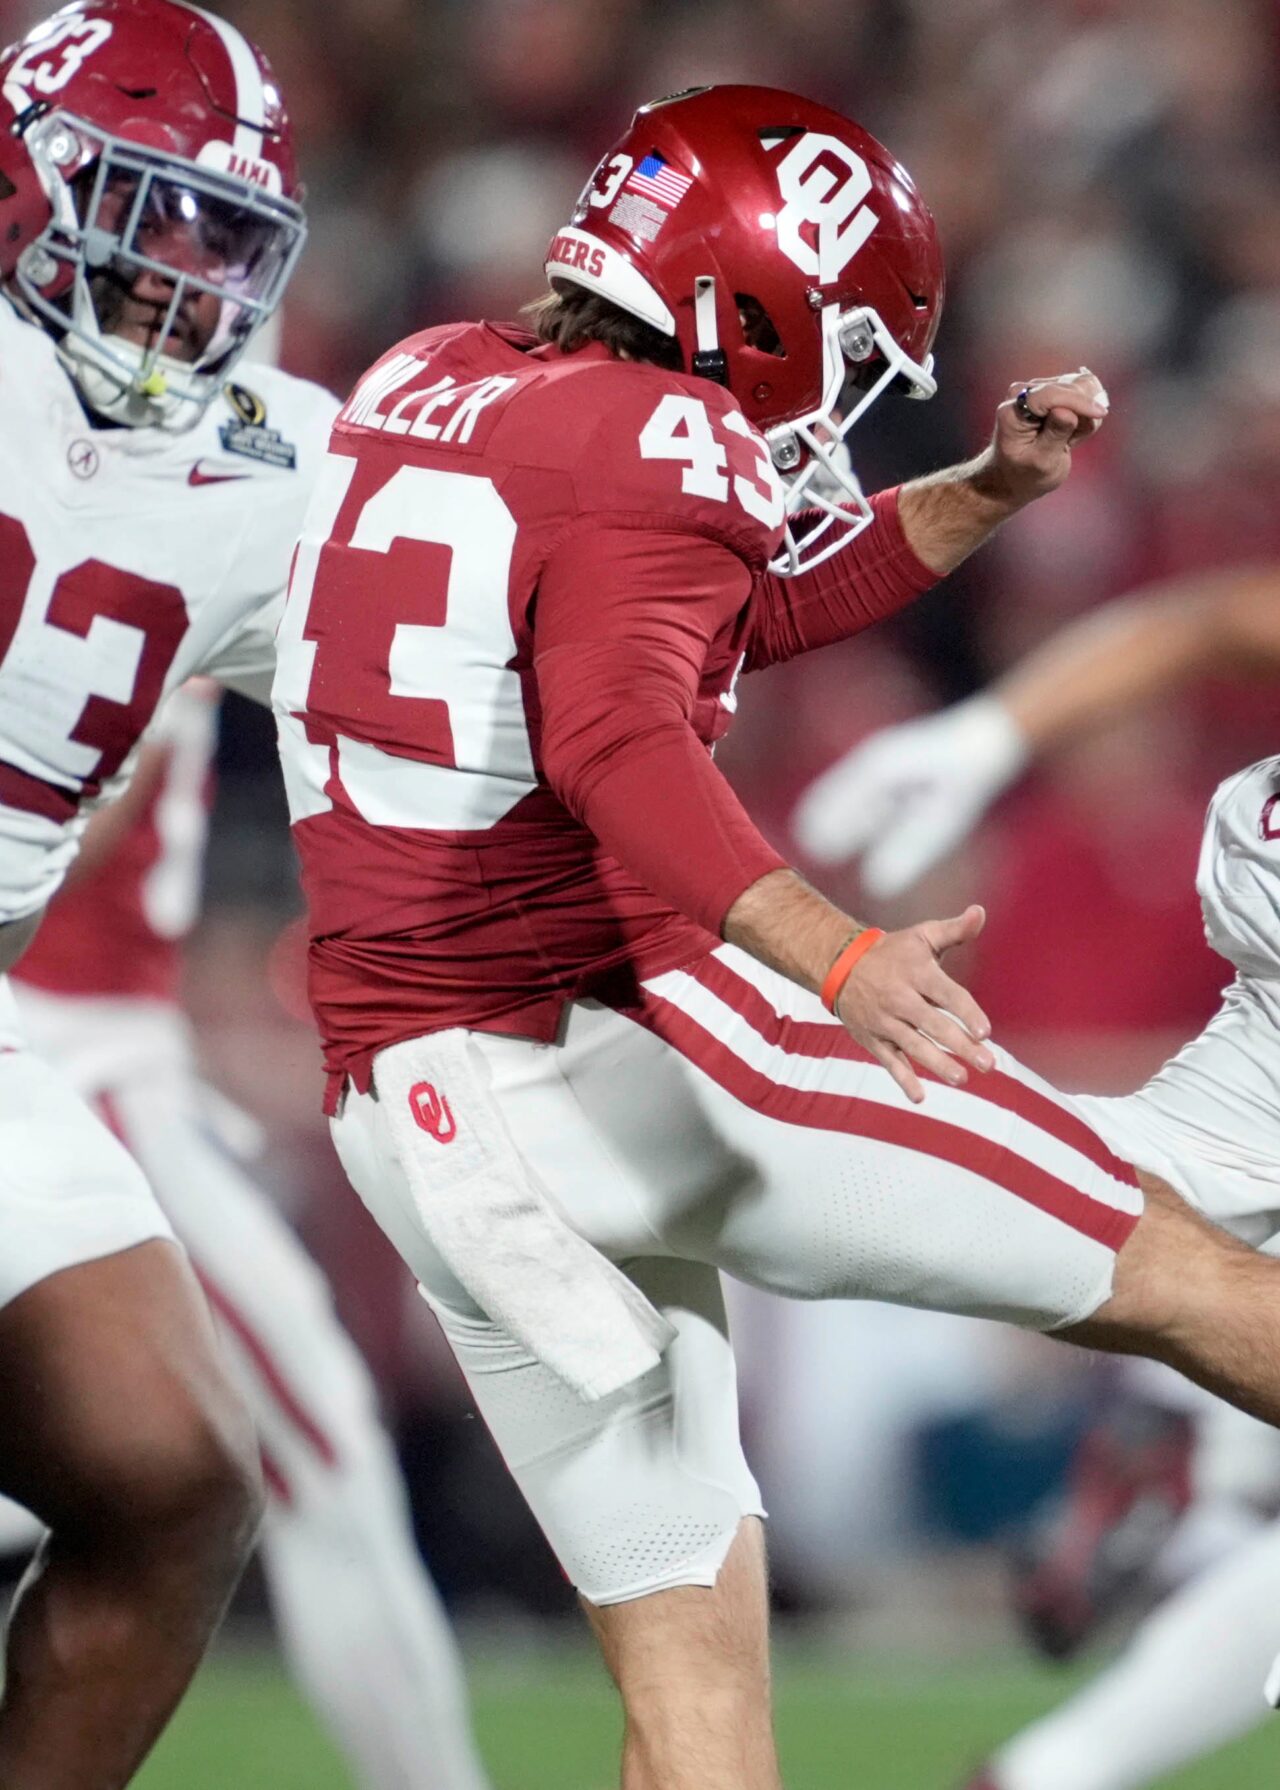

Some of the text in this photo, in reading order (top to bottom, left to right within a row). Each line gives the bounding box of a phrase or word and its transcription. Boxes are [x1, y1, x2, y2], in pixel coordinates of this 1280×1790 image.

[5, 13, 112, 94] 23
[582, 152, 633, 208] 3
[638, 394, 786, 531] 43
[0, 511, 190, 797] 3
[408, 1081, 456, 1144] OU
